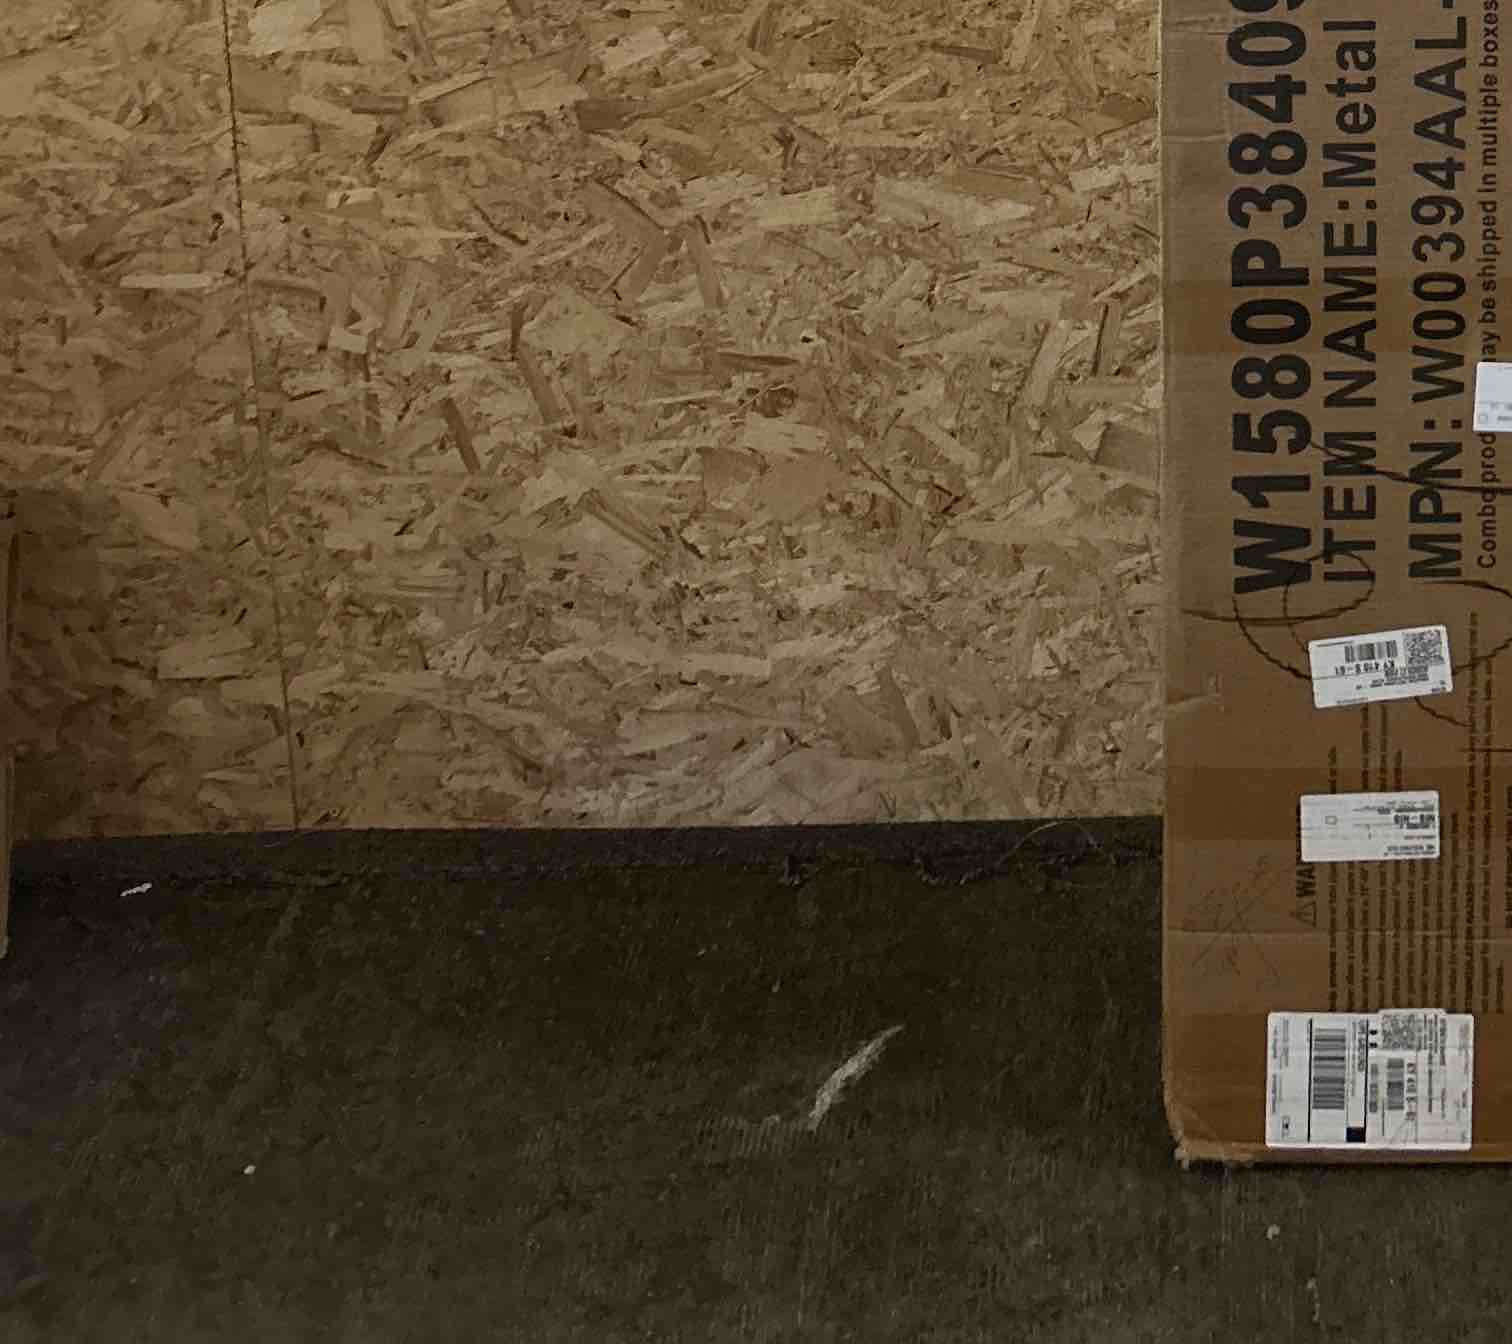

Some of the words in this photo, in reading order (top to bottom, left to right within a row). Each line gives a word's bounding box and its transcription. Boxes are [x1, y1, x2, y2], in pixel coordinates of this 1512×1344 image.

[1479, 0, 1498, 67] boxes
[1478, 74, 1503, 167] multiple
[1478, 174, 1498, 192] in
[1478, 200, 1504, 293] shipped
[1478, 296, 1497, 324] be
[1322, 432, 1377, 583] ITEM
[1407, 419, 1463, 579] MPN:
[1476, 489, 1498, 569] Combo
